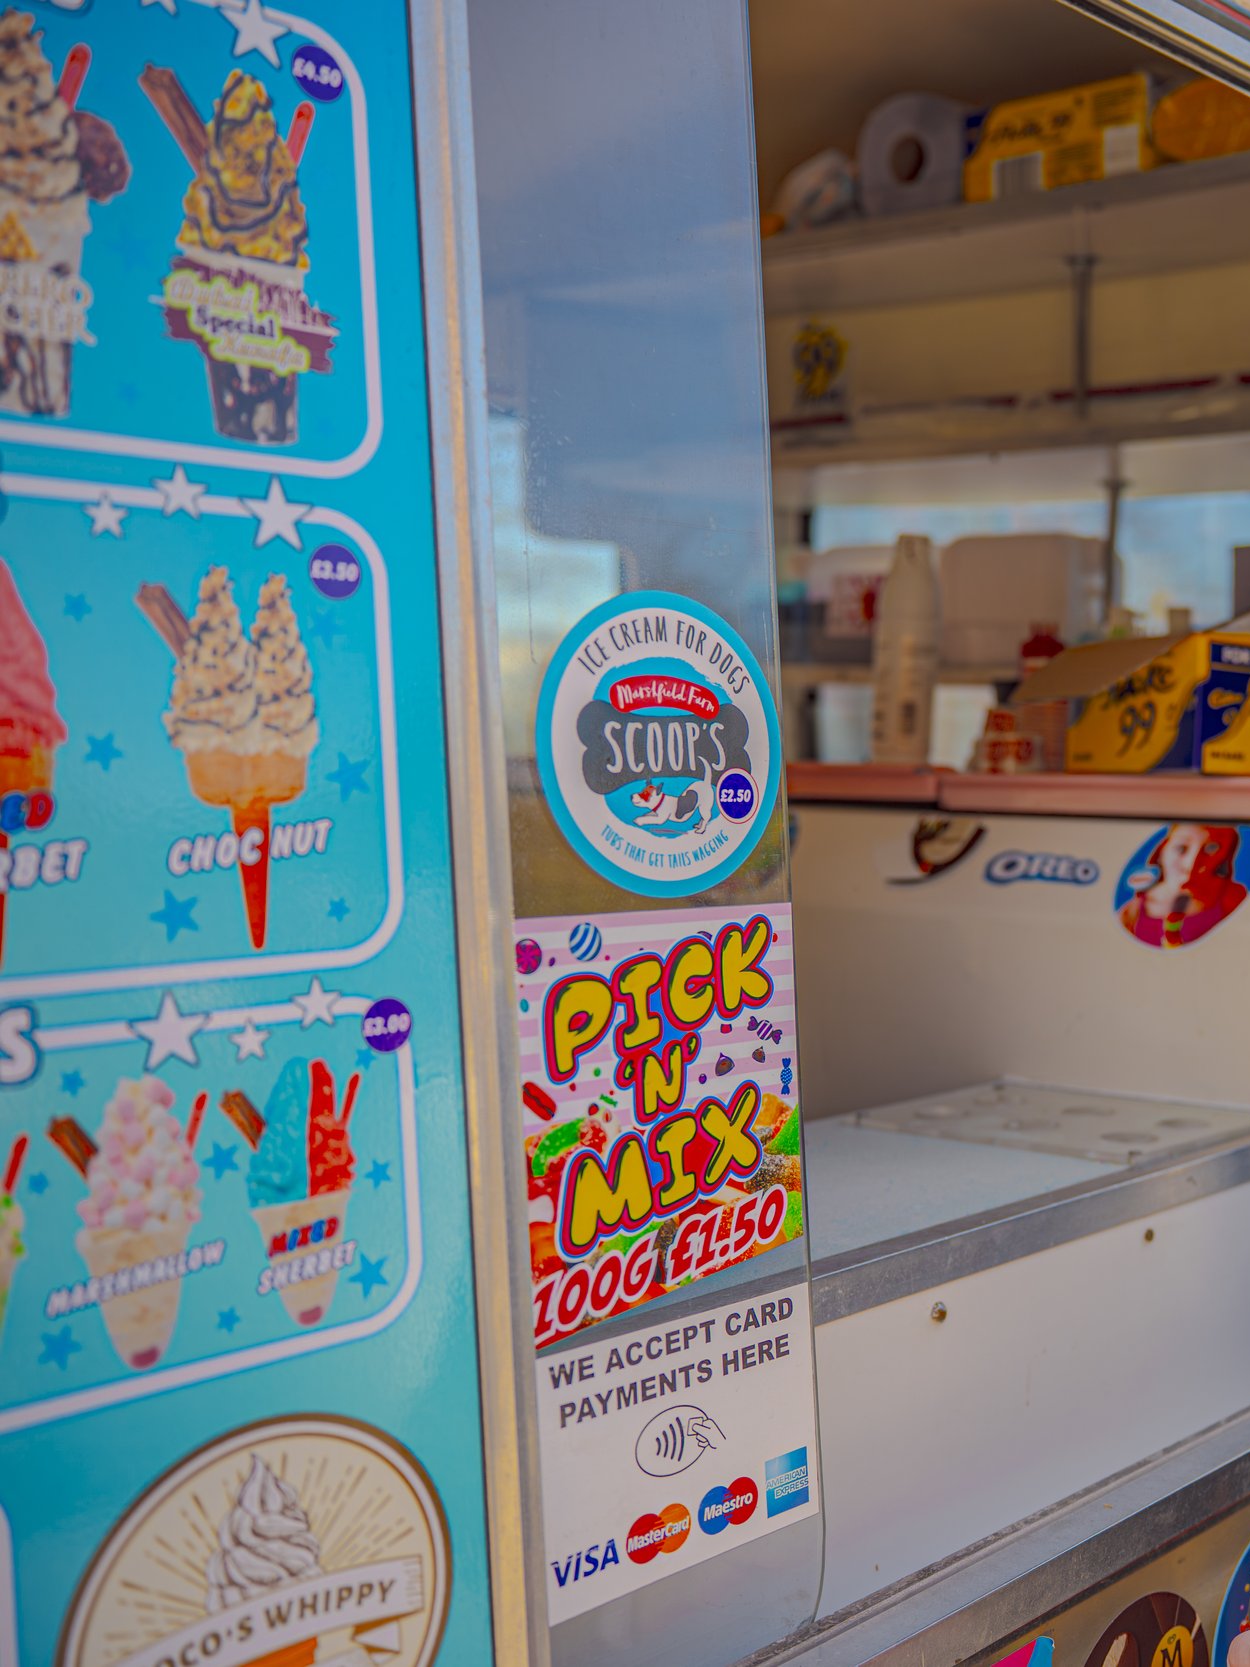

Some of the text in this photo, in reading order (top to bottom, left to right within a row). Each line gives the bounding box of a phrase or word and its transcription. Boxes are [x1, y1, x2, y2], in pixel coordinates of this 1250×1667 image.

[292, 57, 342, 88] £4.50
[198, 306, 275, 338] Special
[577, 616, 750, 695] ICE CREAM FOR DOGS
[616, 680, 715, 712] Marshfield Farm
[604, 721, 726, 774] SCOOP'S
[1115, 702, 1156, 758] 99
[720, 788, 751, 803] £2.50
[169, 819, 333, 876] CHOC NUT
[601, 825, 729, 869] TUBS THAT GET TAILS WAGGING
[551, 918, 773, 1076] PICK
[569, 1086, 760, 1247] MIX
[267, 1216, 339, 1258] MIXED
[535, 1188, 787, 1340] 100G £1.50
[46, 1238, 226, 1320] MARSHMALLOW
[257, 1239, 356, 1295] SHERBET
[549, 1297, 793, 1390] WE ACCEPT CARD
[560, 1334, 790, 1428] PAYMENTS HERE
[775, 1478, 808, 1498] EXPRESS
[551, 1467, 806, 1588] VISA MasterCard Maestro AMERICAN
[264, 1578, 396, 1630] WHIPPY
